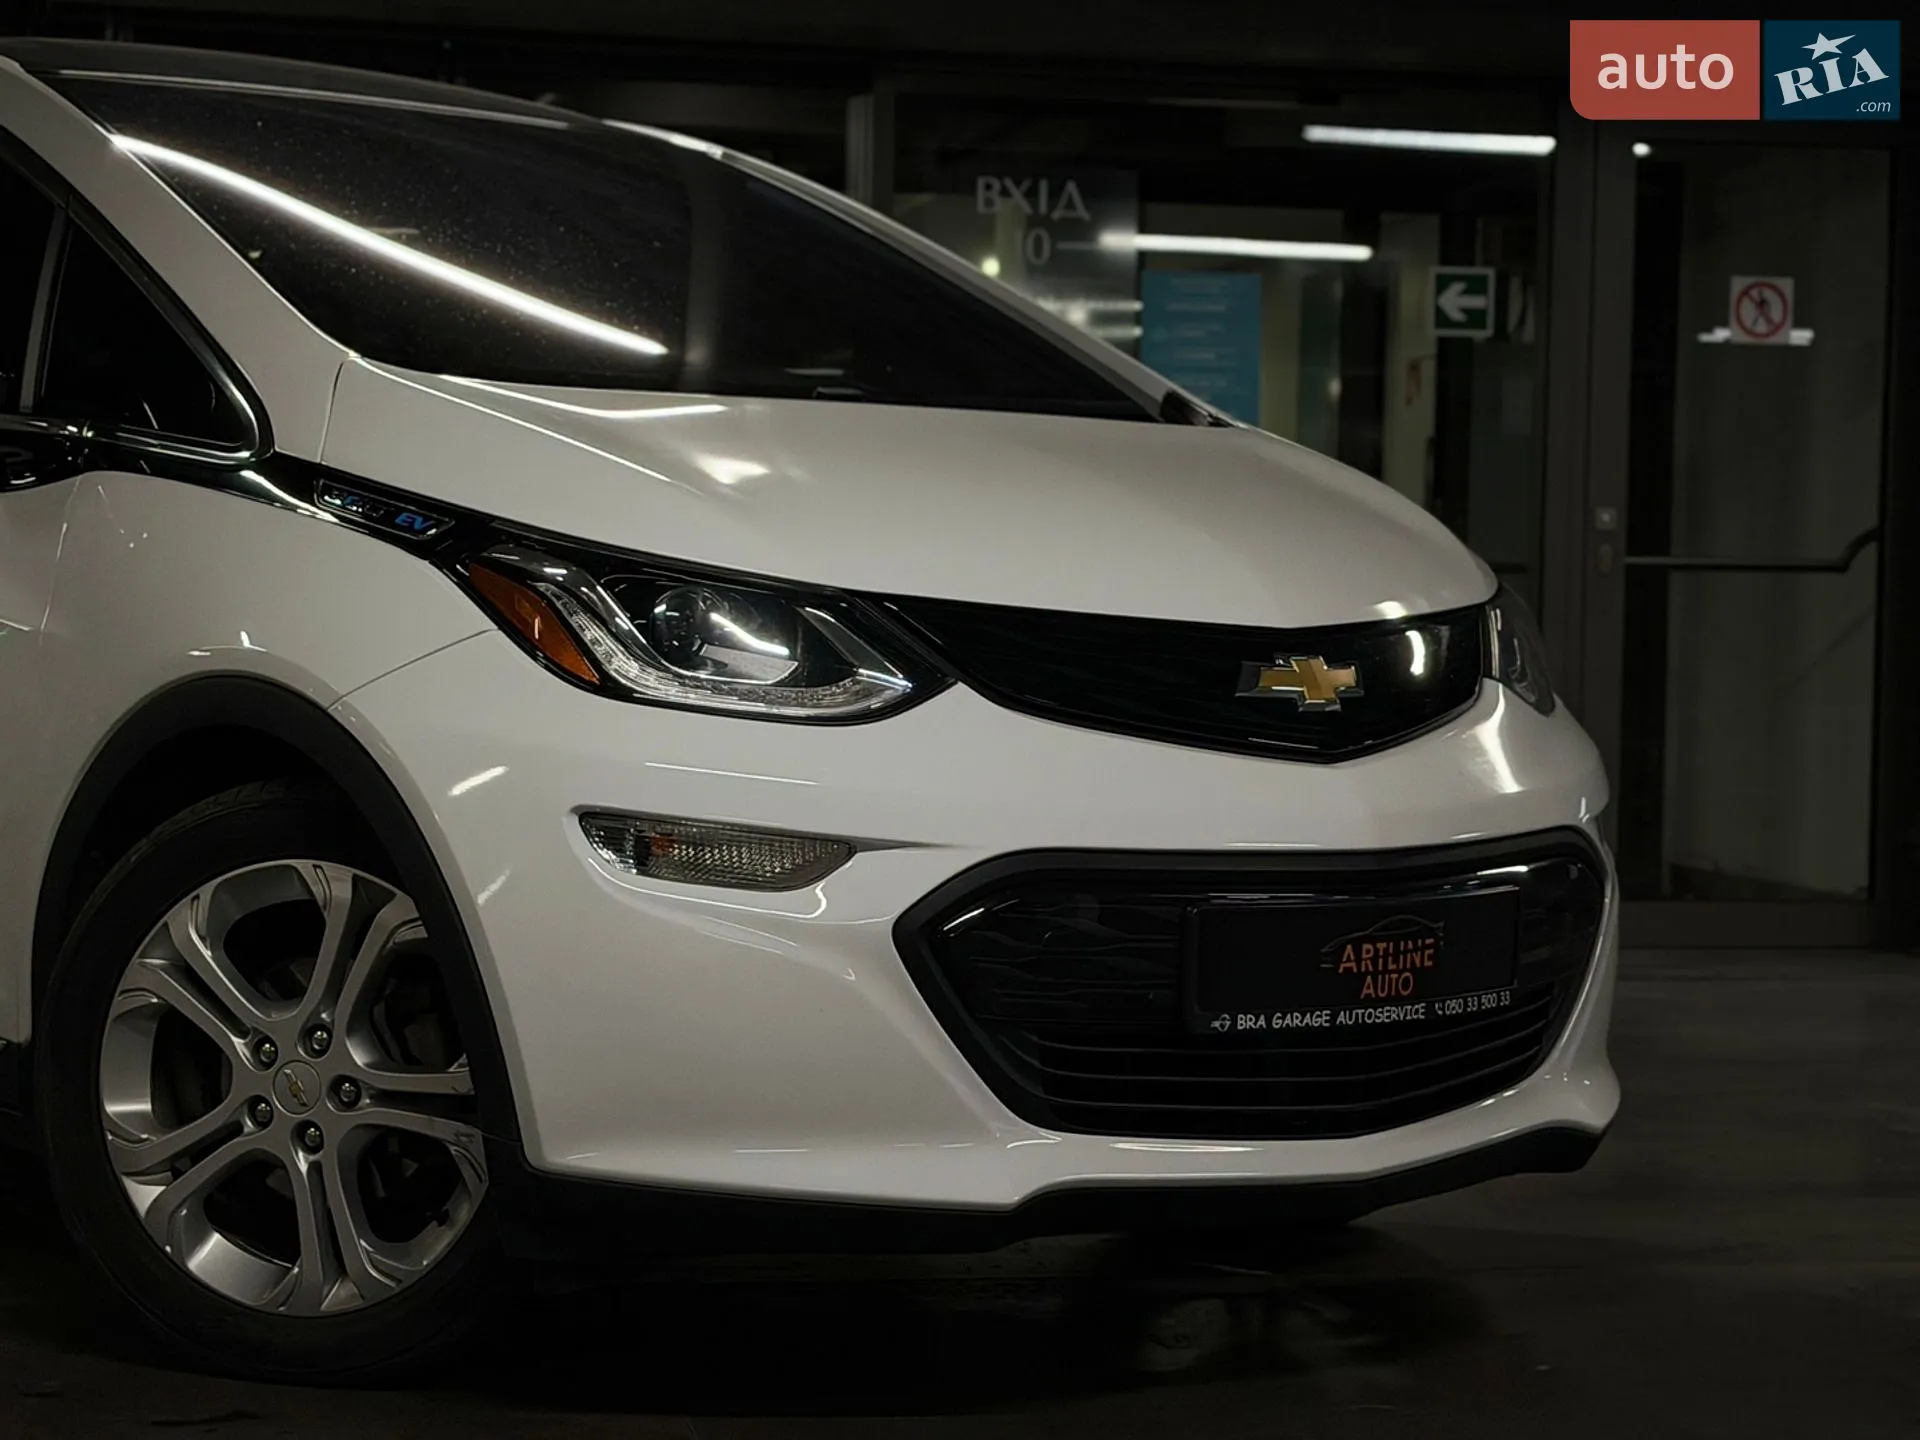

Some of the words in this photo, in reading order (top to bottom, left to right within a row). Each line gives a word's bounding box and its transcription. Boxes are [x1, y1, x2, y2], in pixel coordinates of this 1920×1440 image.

[976, 175, 1091, 221] ВХІД
[394, 511, 437, 531] EV
[1337, 937, 1435, 974] ARTLINE
[1359, 971, 1414, 1000] AUTO
[1236, 1013, 1267, 1031] BRA
[1271, 1009, 1332, 1030] GARAGE
[1336, 1002, 1426, 1026] AUTOSERVICE
[1466, 995, 1478, 1013] 33
[1499, 989, 1511, 1006] 33
